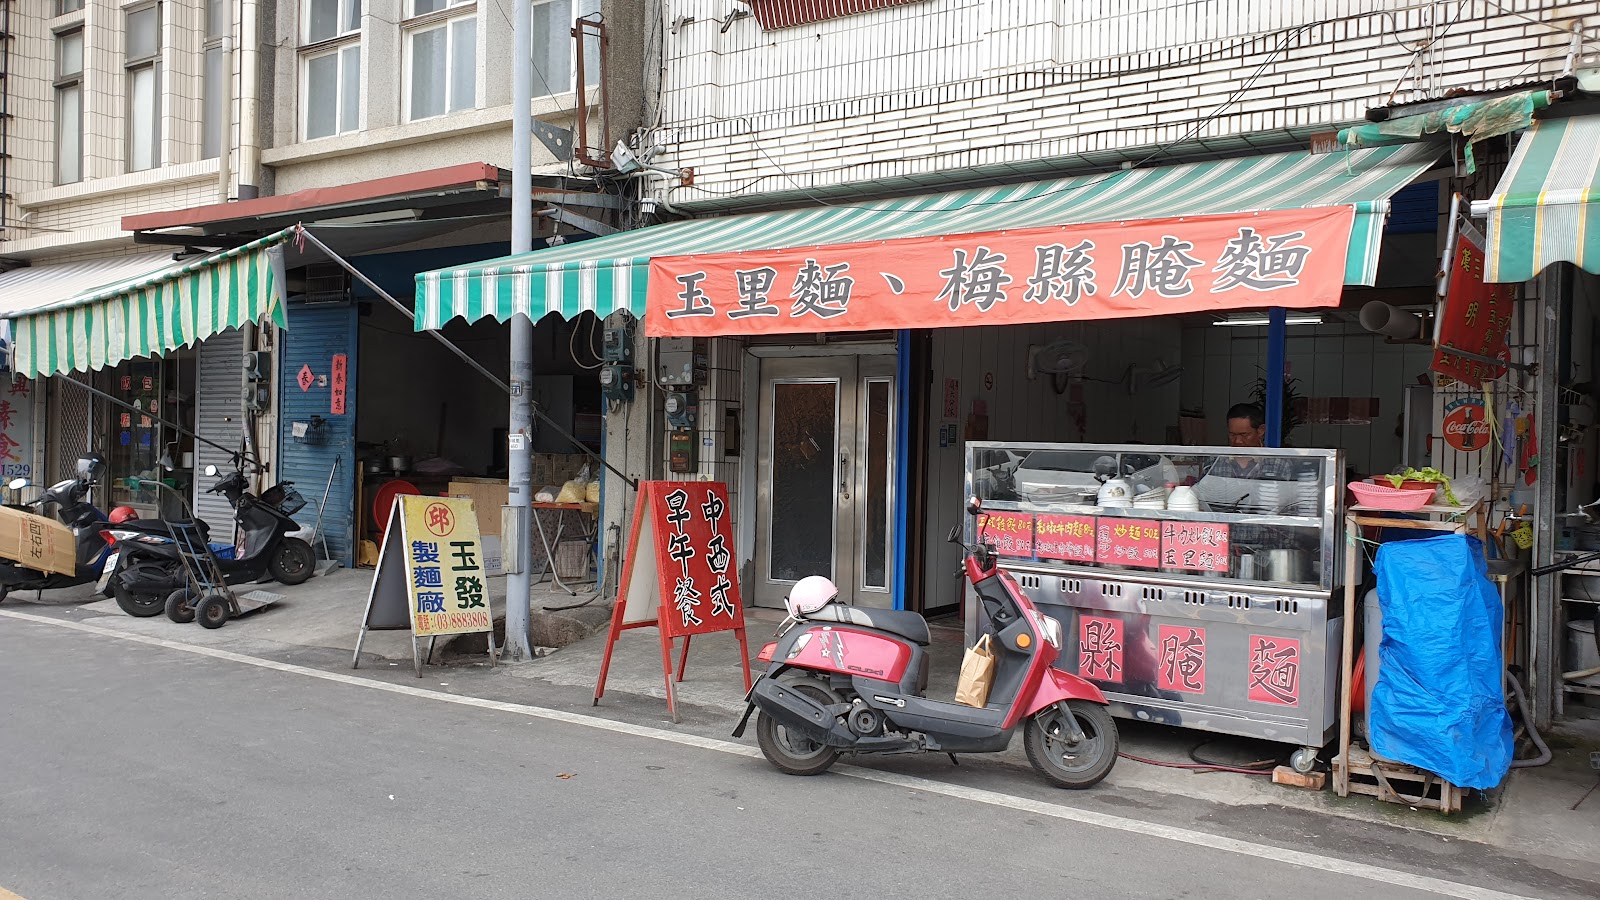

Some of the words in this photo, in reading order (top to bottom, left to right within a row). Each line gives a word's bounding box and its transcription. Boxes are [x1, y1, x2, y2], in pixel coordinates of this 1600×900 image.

[335, 359, 343, 410] 新春如意
[1448, 398, 1485, 410] ALWAY
[1446, 419, 1490, 434] Coca-Cola
[429, 506, 450, 534] 邱
[411, 540, 447, 613] 製麵廠
[449, 541, 486, 609] 玉發
[665, 488, 703, 627] 早午餐
[701, 489, 735, 619] 中西式
